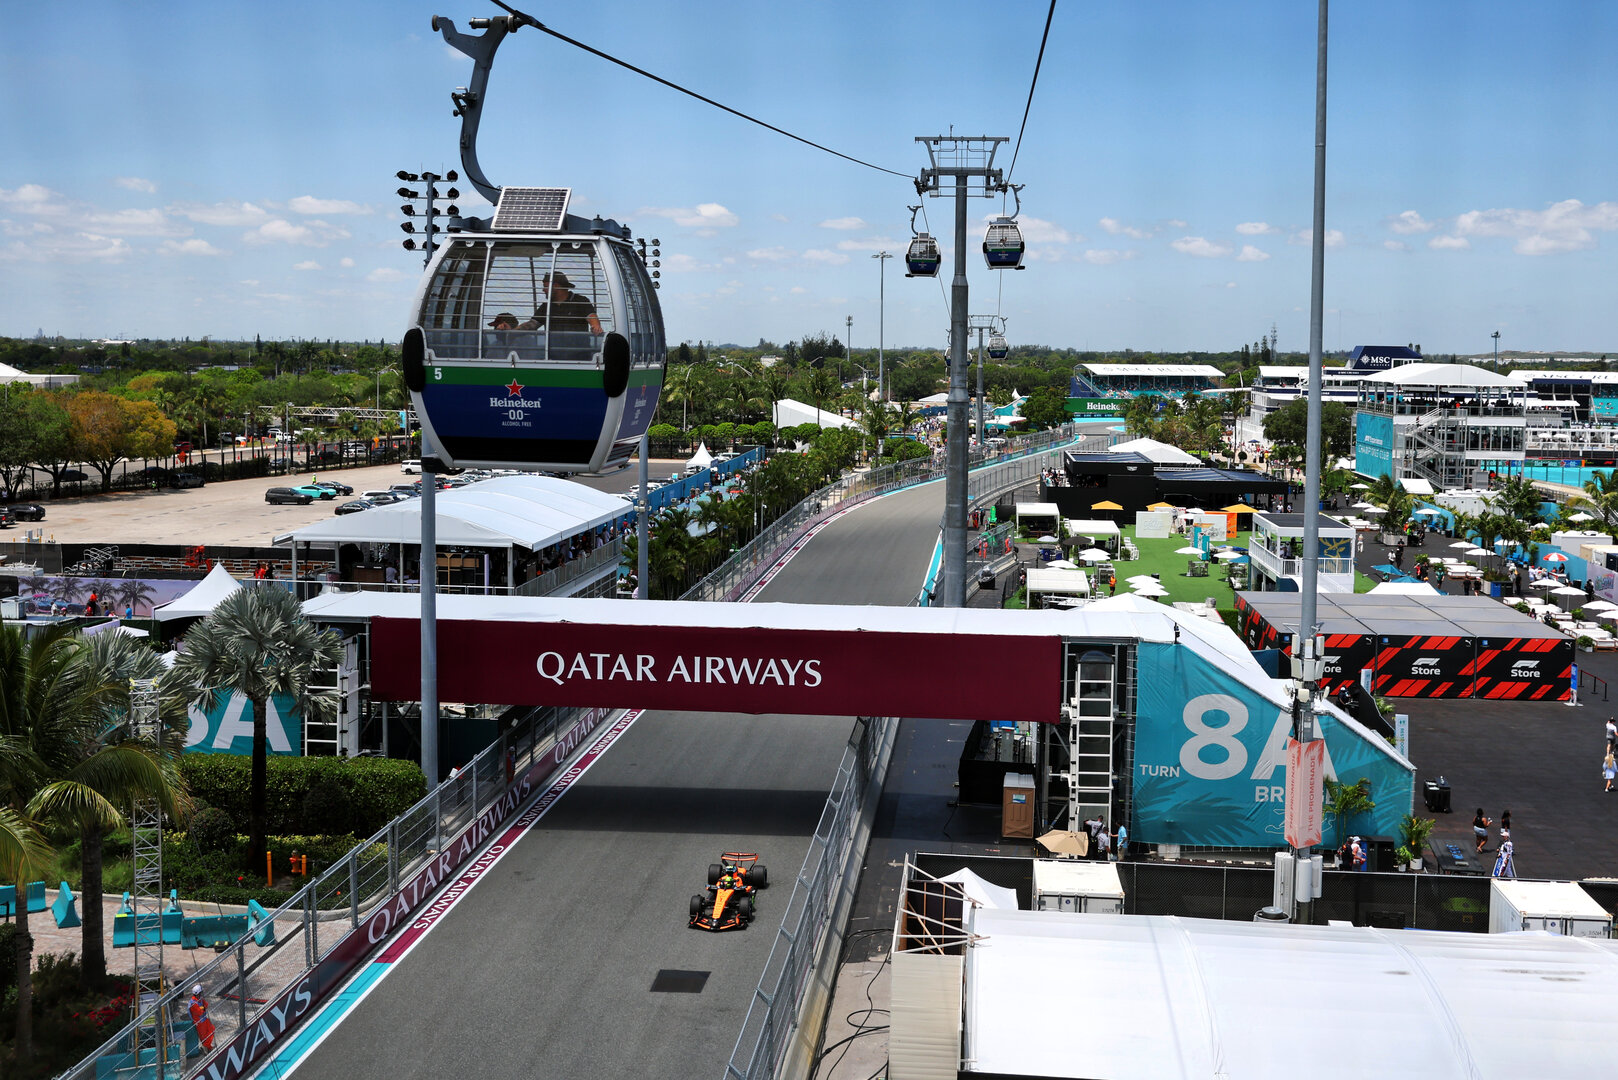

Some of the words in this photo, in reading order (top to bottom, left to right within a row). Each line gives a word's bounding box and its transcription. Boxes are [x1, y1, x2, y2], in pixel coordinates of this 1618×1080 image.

[434, 367, 443, 380] 5
[1370, 356, 1390, 364] MSC
[489, 397, 542, 409] Heineken
[1086, 402, 1124, 411] Heinek
[536, 651, 657, 685] QATAR
[667, 655, 822, 688] AIRWAYS
[1411, 666, 1441, 675] Store
[1511, 669, 1541, 678] Store
[554, 711, 594, 764] QATAR
[551, 767, 582, 792] QATAR
[1139, 764, 1180, 778] TURN
[1308, 755, 1316, 813] PROMENADE
[518, 792, 556, 826] AIRWAYS
[368, 850, 452, 945] QATAR
[457, 774, 531, 863] AIRWAYS
[463, 845, 504, 879] QATAR
[413, 880, 469, 930] AIRWAYS
[195, 977, 312, 1080] WAYS
